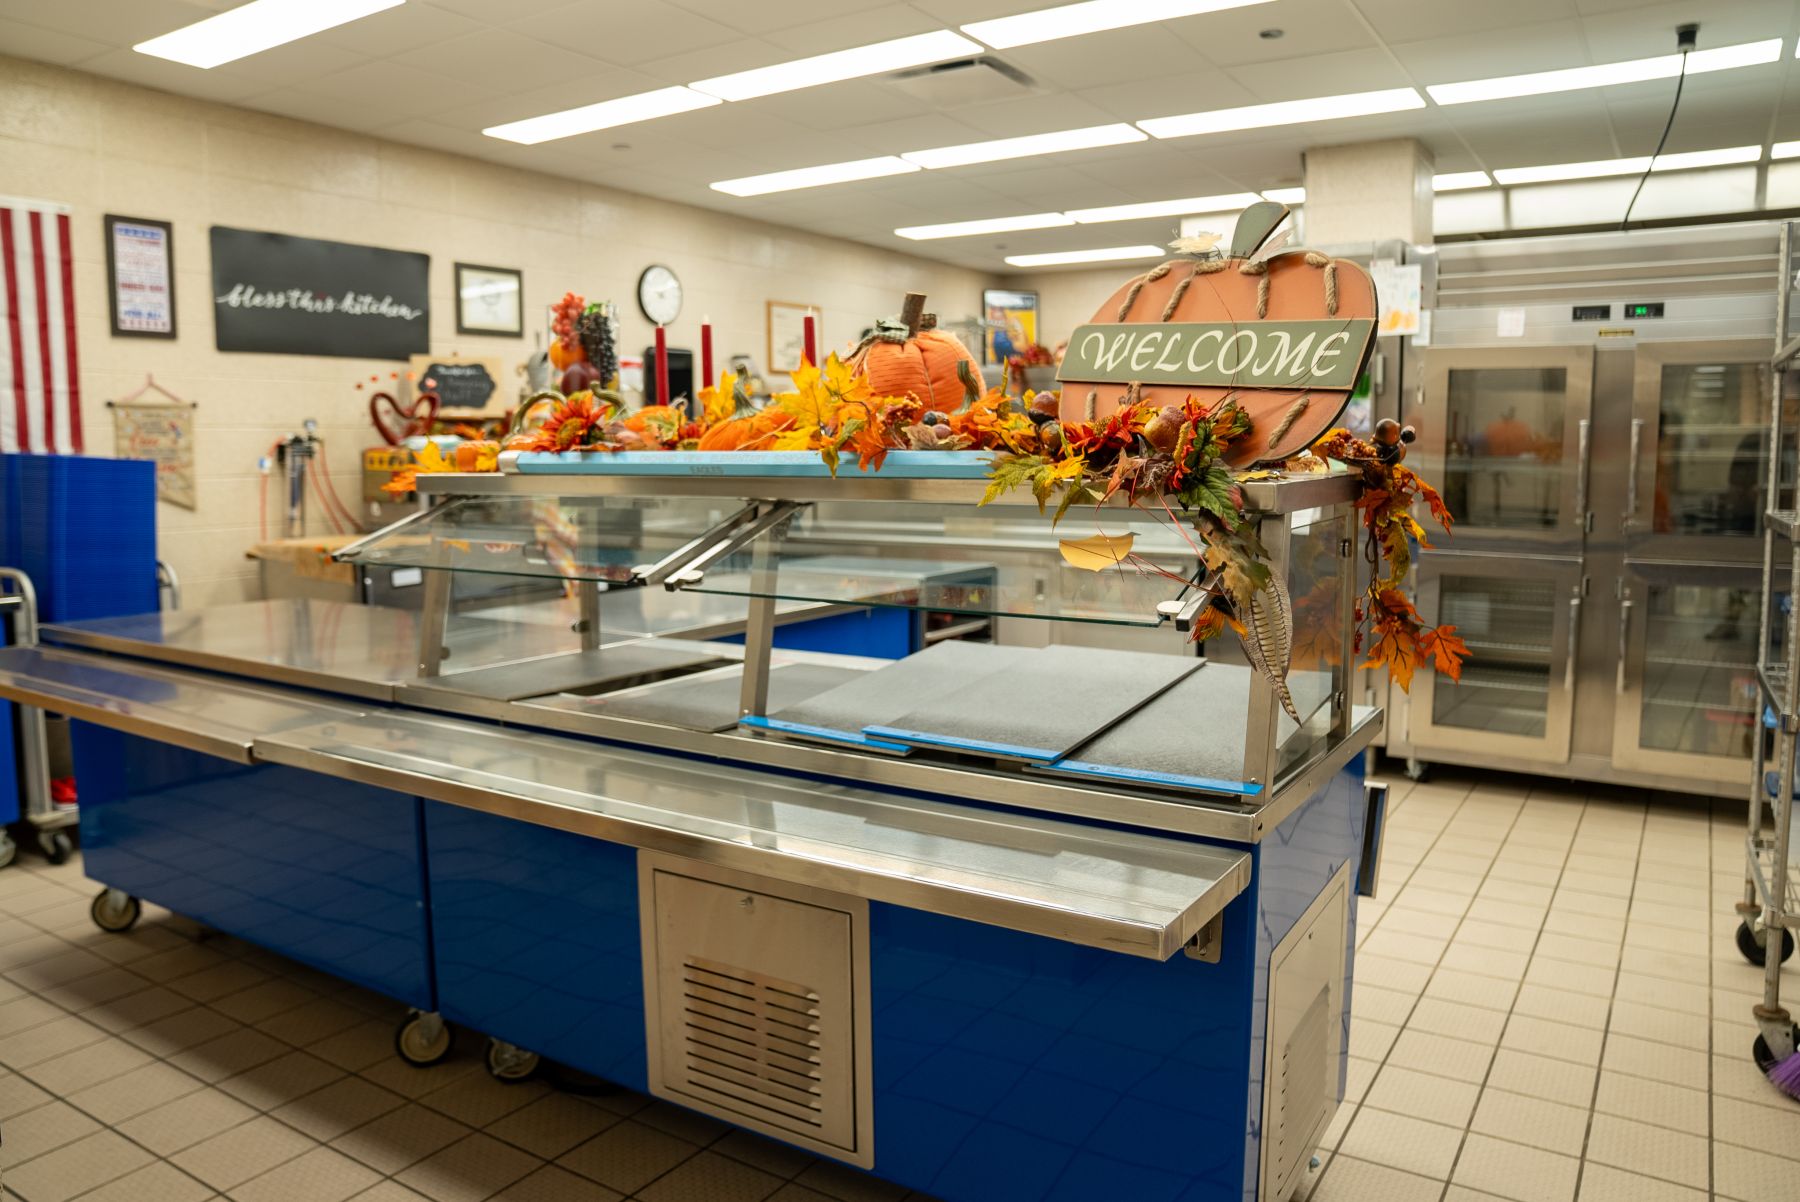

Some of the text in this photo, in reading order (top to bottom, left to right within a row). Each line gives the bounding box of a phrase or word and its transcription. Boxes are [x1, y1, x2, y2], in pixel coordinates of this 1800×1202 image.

[216, 283, 422, 320] bless this kitchen
[1080, 329, 1350, 376] WELCOME
